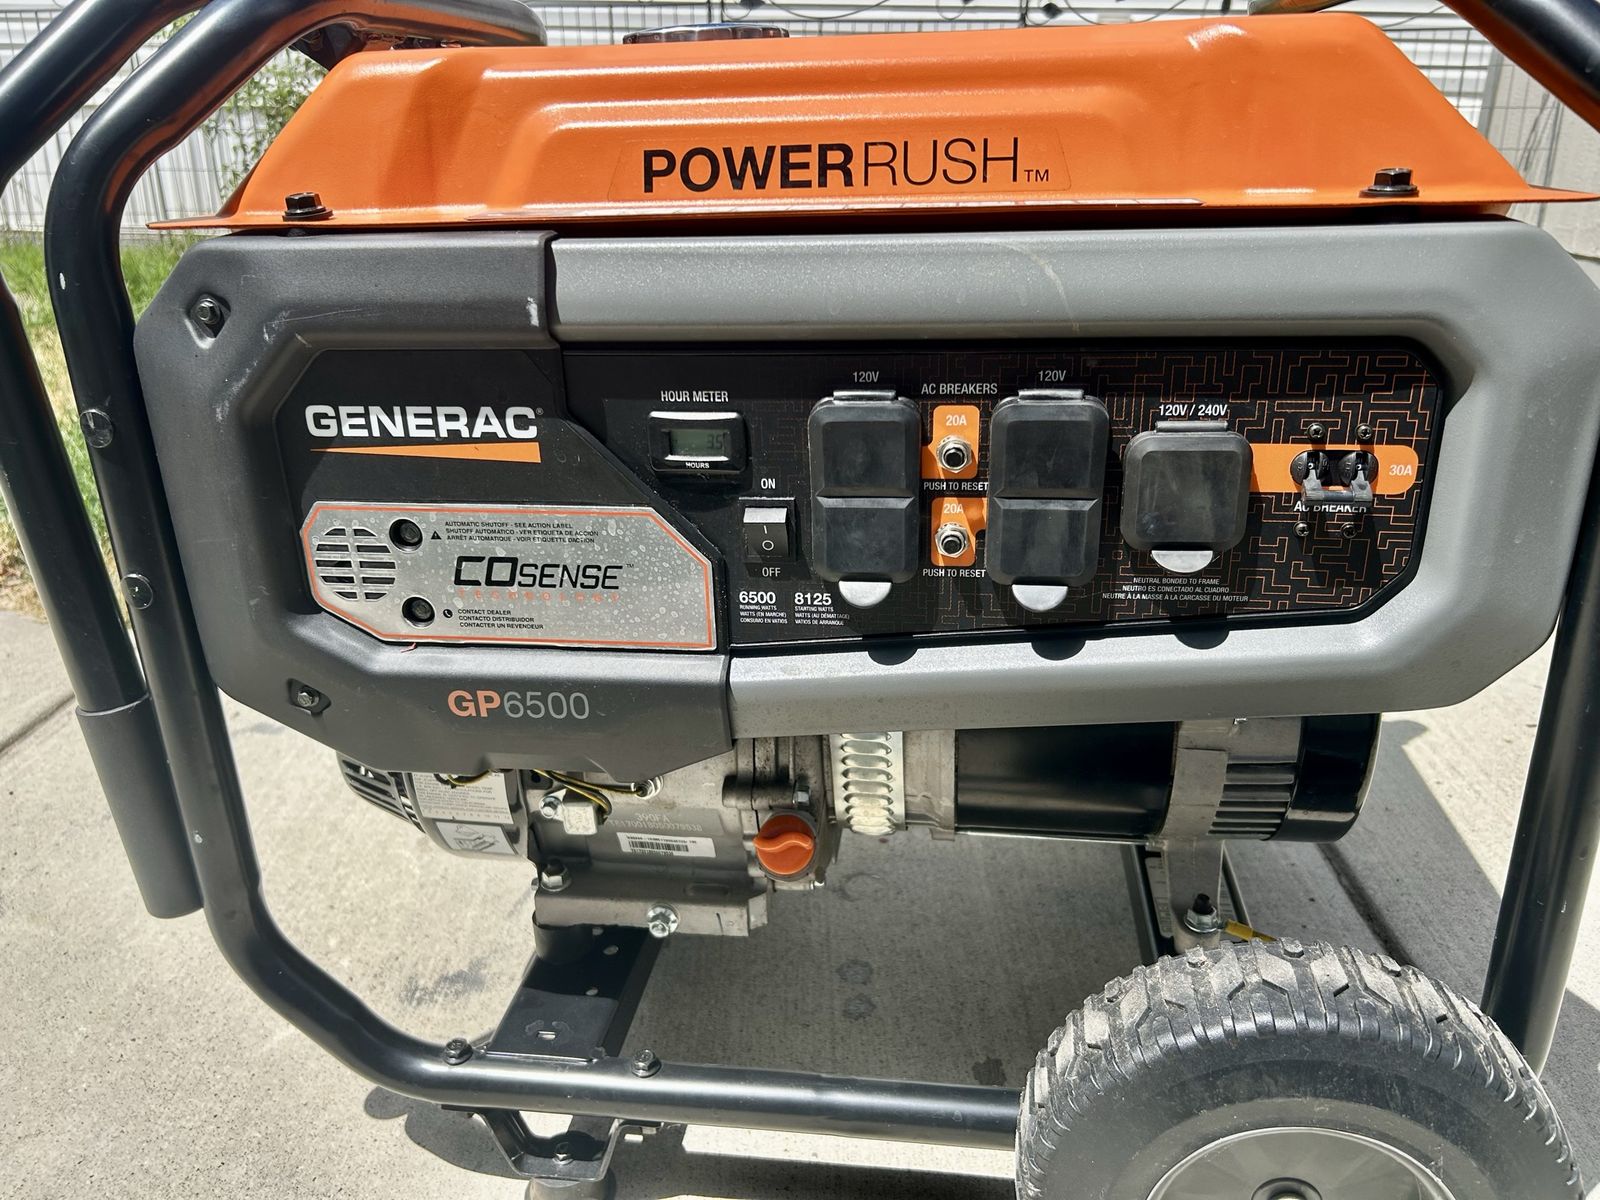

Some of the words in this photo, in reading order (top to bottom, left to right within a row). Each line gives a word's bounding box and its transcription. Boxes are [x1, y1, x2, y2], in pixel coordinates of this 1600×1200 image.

[852, 371, 880, 383] 120V
[1038, 370, 1066, 381] 120V
[921, 384, 936, 395] AC
[939, 383, 998, 395] BREAKERS
[660, 391, 690, 402] HOUR
[692, 391, 729, 402] METER
[1159, 404, 1188, 416] 120V
[1197, 404, 1228, 416] 240V
[945, 415, 967, 426] 20A
[685, 461, 710, 469] HOURS
[1388, 465, 1413, 476] 30A
[760, 478, 776, 489] ON
[923, 481, 947, 491] PUSH
[949, 482, 960, 491] TO
[961, 482, 989, 491] RESET
[943, 503, 964, 514] 20A
[762, 567, 781, 577] OFF
[922, 569, 945, 579] PUSH
[947, 570, 958, 579] TO
[959, 569, 987, 579] RESET
[1157, 585, 1194, 593] CONECTADO
[739, 591, 776, 604] 6500
[794, 592, 832, 606] 8125
[1102, 592, 1126, 600] NEUTRE
[1169, 593, 1178, 601] LA
[1212, 594, 1222, 602] DU
[459, 621, 496, 629] CONTACTER
[447, 690, 590, 719] GP6500
